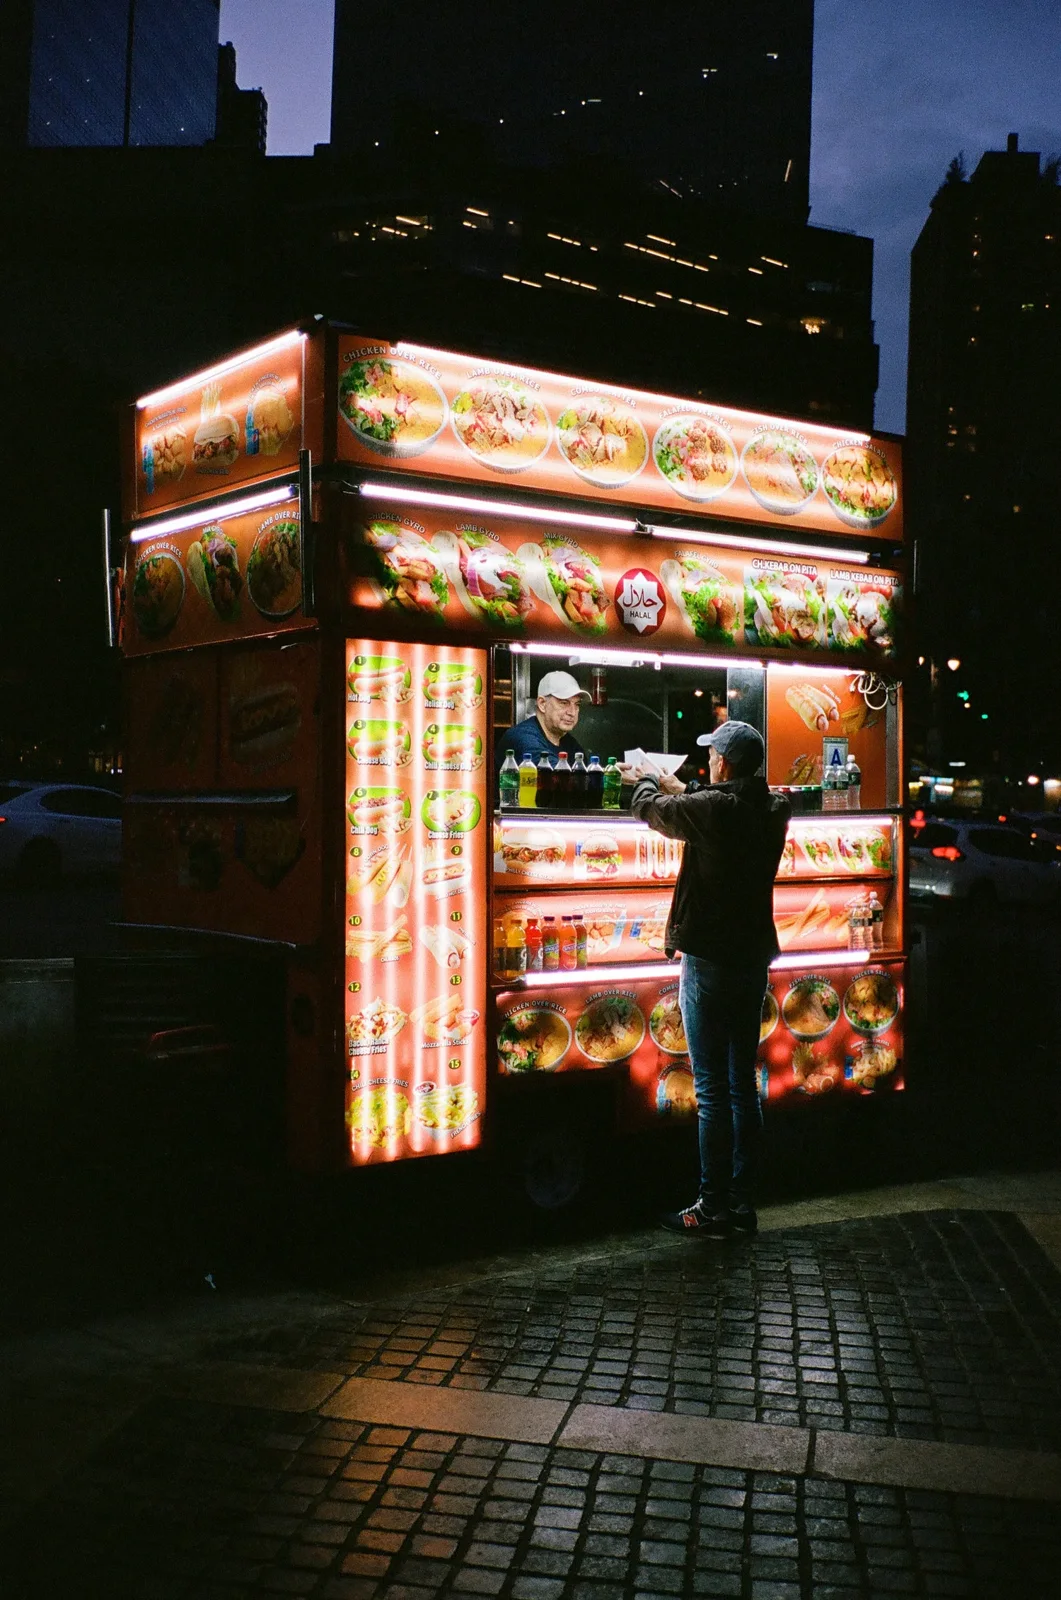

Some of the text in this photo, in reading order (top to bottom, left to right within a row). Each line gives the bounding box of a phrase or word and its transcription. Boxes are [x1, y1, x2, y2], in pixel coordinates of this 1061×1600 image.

[343, 346, 442, 380] CHICKEN OVER RICE
[467, 367, 541, 392] LAMB OVER RICE
[752, 424, 808, 445] FISH OVER RICE
[833, 438, 886, 458] CHICKEN SALAD
[257, 516, 273, 534] LAMB
[274, 511, 290, 521] OVER
[368, 512, 425, 534] CHICKEN GYRO
[455, 524, 500, 542] LAMB GYRO
[543, 532, 579, 549] MIX GYRO
[170, 544, 182, 558] RICE
[752, 559, 818, 576] CH.KEBAB ON PITA
[830, 569, 898, 587] LAMB KEBAB ON PITA
[622, 584, 658, 608] حلال
[630, 611, 652, 619] HALAL
[831, 748, 842, 766] A
[450, 831, 464, 840] Fries
[452, 976, 460, 984] 13
[789, 977, 801, 988] FISH
[852, 970, 874, 982] CHICKEN
[350, 983, 360, 991] 12
[659, 983, 679, 996] COMBO
[585, 992, 602, 1004] LAMB
[621, 989, 637, 1000] RICE
[551, 1003, 567, 1014] RICE
[371, 1046, 387, 1055] Fries
